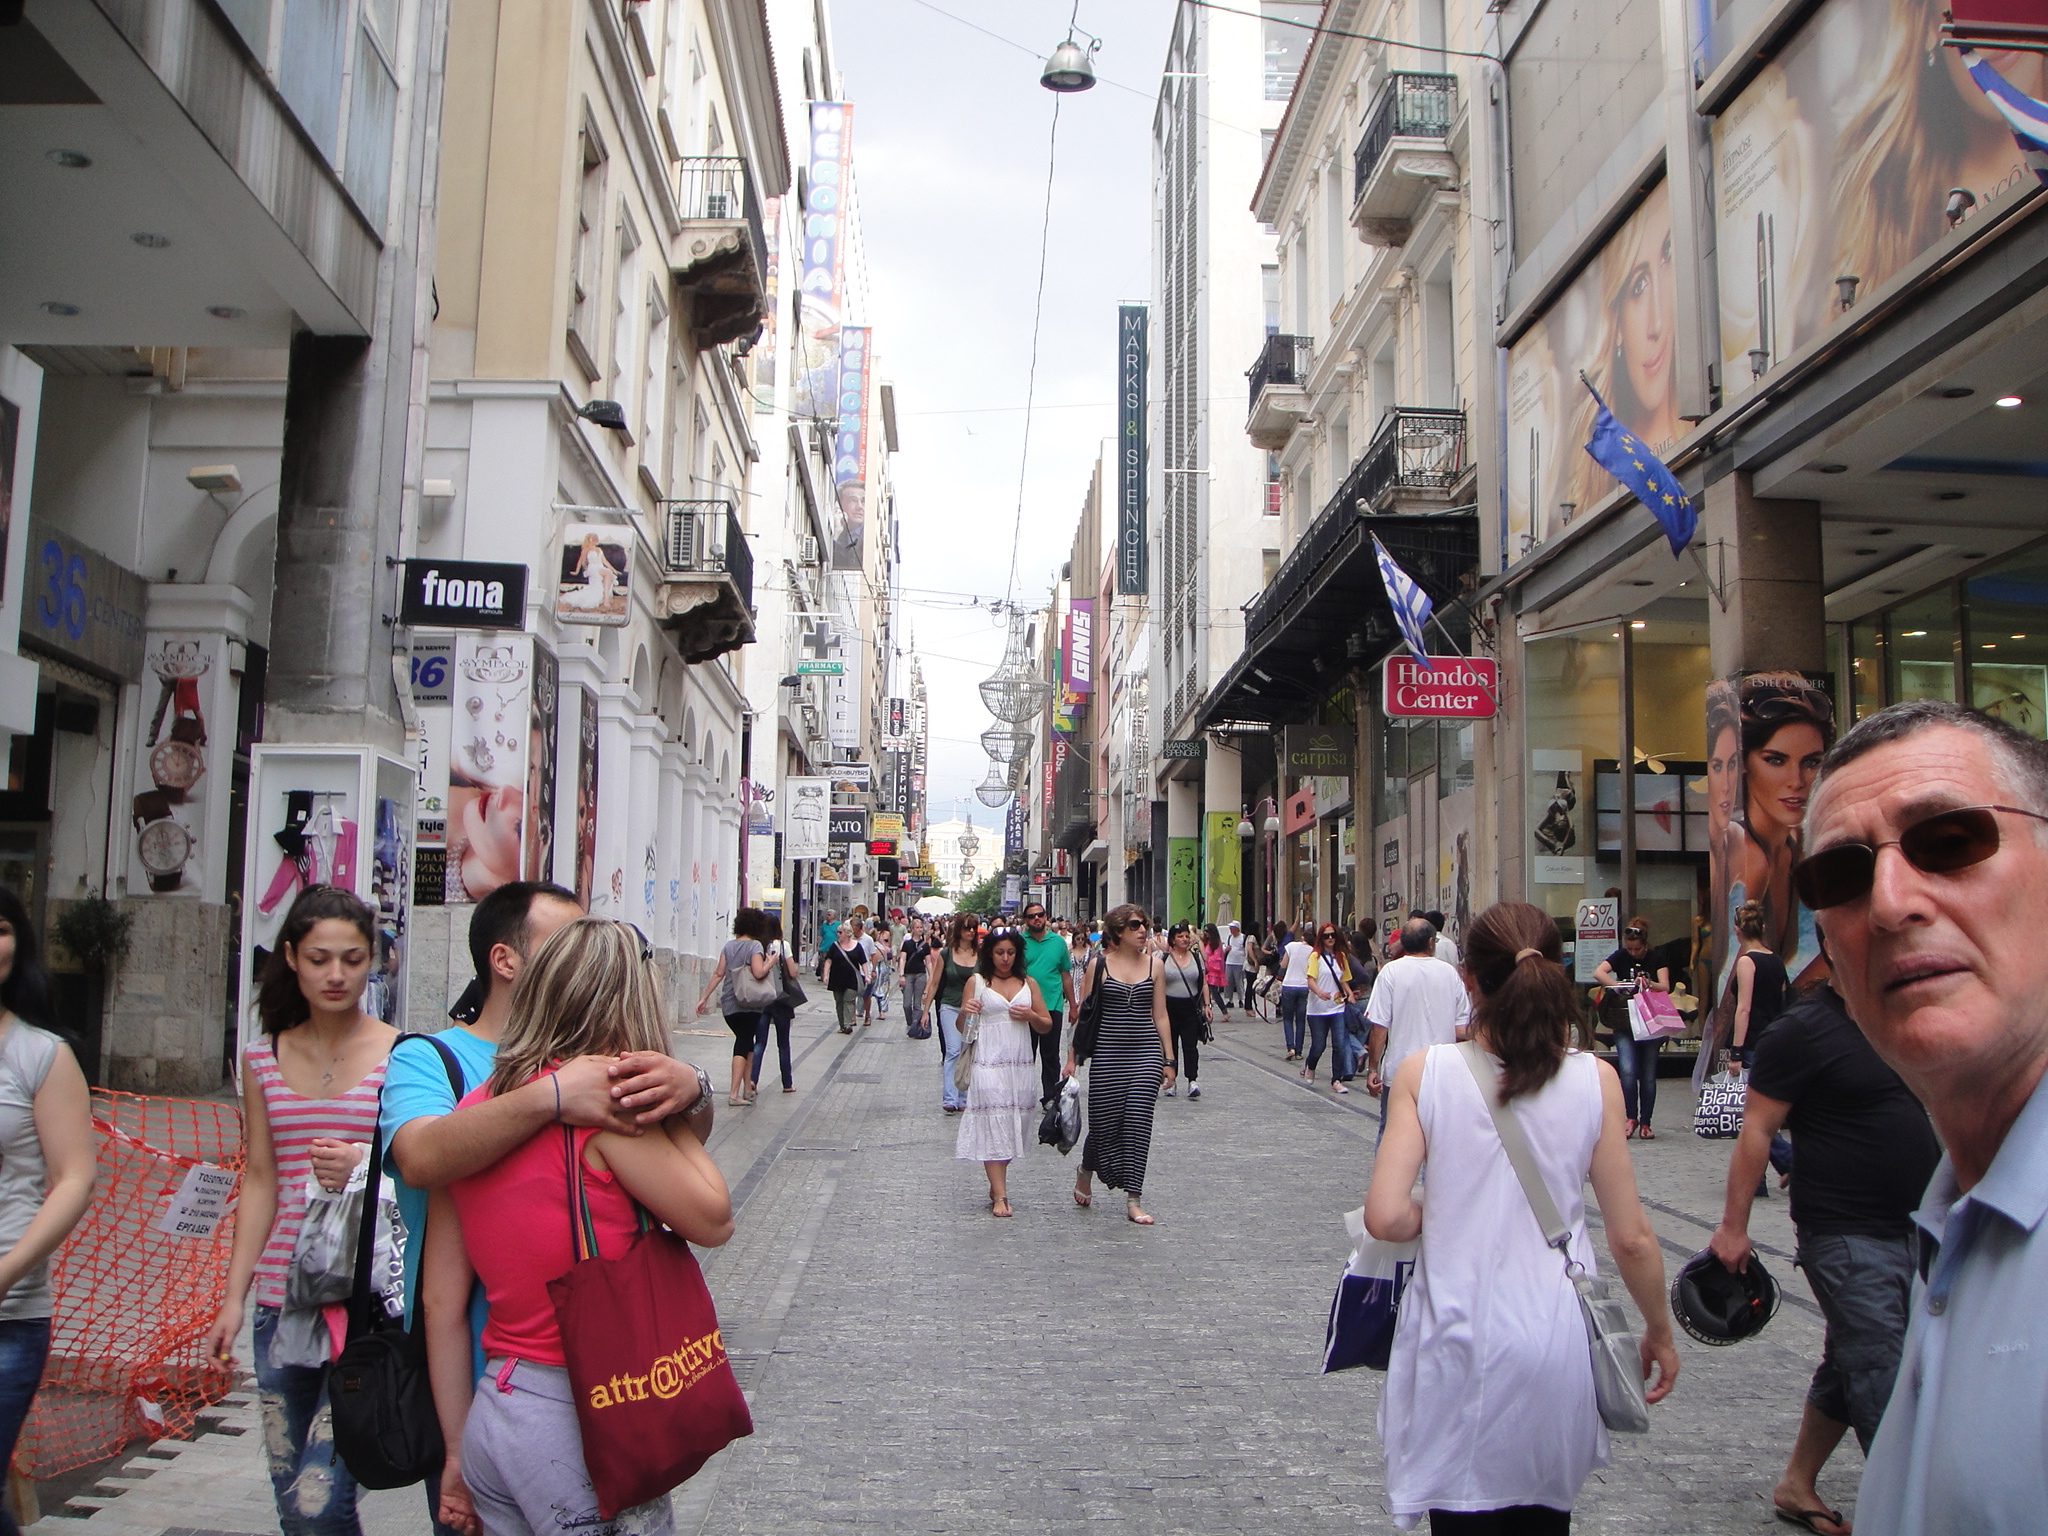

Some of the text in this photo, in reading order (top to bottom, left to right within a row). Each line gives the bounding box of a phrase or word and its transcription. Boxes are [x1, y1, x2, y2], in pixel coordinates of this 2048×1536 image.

[1125, 316, 1141, 585] MARKS & SPENCER
[38, 540, 142, 640] 36 CENTER
[423, 569, 504, 609] fiona
[1071, 608, 1091, 683] GINIS
[459, 658, 528, 669] SYMBOL
[1397, 663, 1488, 687] Hondos
[1397, 685, 1478, 709] Center
[1165, 749, 1200, 757] SPENCER
[1292, 752, 1347, 769] carpisa
[418, 820, 445, 833] tyle
[1014, 801, 1022, 837] FOKAS
[416, 853, 446, 862] ОВАЯ
[415, 863, 444, 873] РИКА
[1579, 903, 1615, 928] 25%
[1702, 1082, 1726, 1091] Blanco
[1702, 1088, 1747, 1106] Blanc
[1723, 1105, 1745, 1113] Blanco
